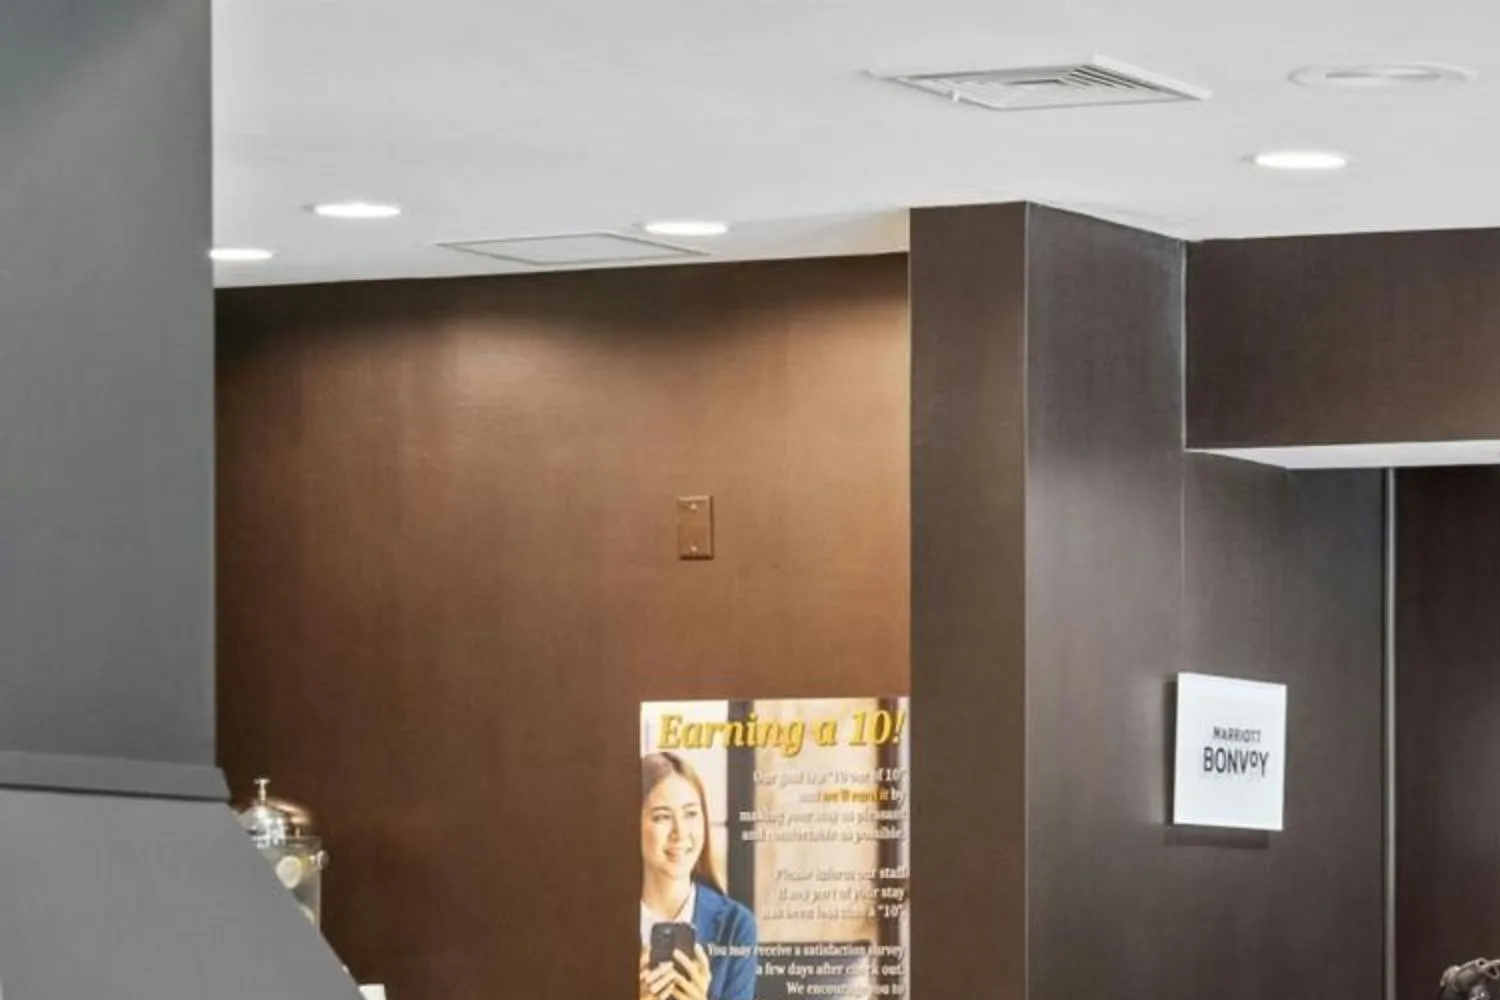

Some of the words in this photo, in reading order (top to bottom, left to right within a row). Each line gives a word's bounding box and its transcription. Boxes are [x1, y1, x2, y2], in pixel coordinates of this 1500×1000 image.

[658, 714, 805, 757] Earning
[810, 718, 837, 747] a
[849, 710, 907, 746] 10!
[1213, 726, 1262, 742] MARRIOTT
[1203, 747, 1269, 777] BONVOY
[764, 962, 785, 975] few
[787, 962, 814, 978] days
[815, 962, 844, 975] after
[846, 962, 878, 975] chk
[785, 981, 804, 994] We
